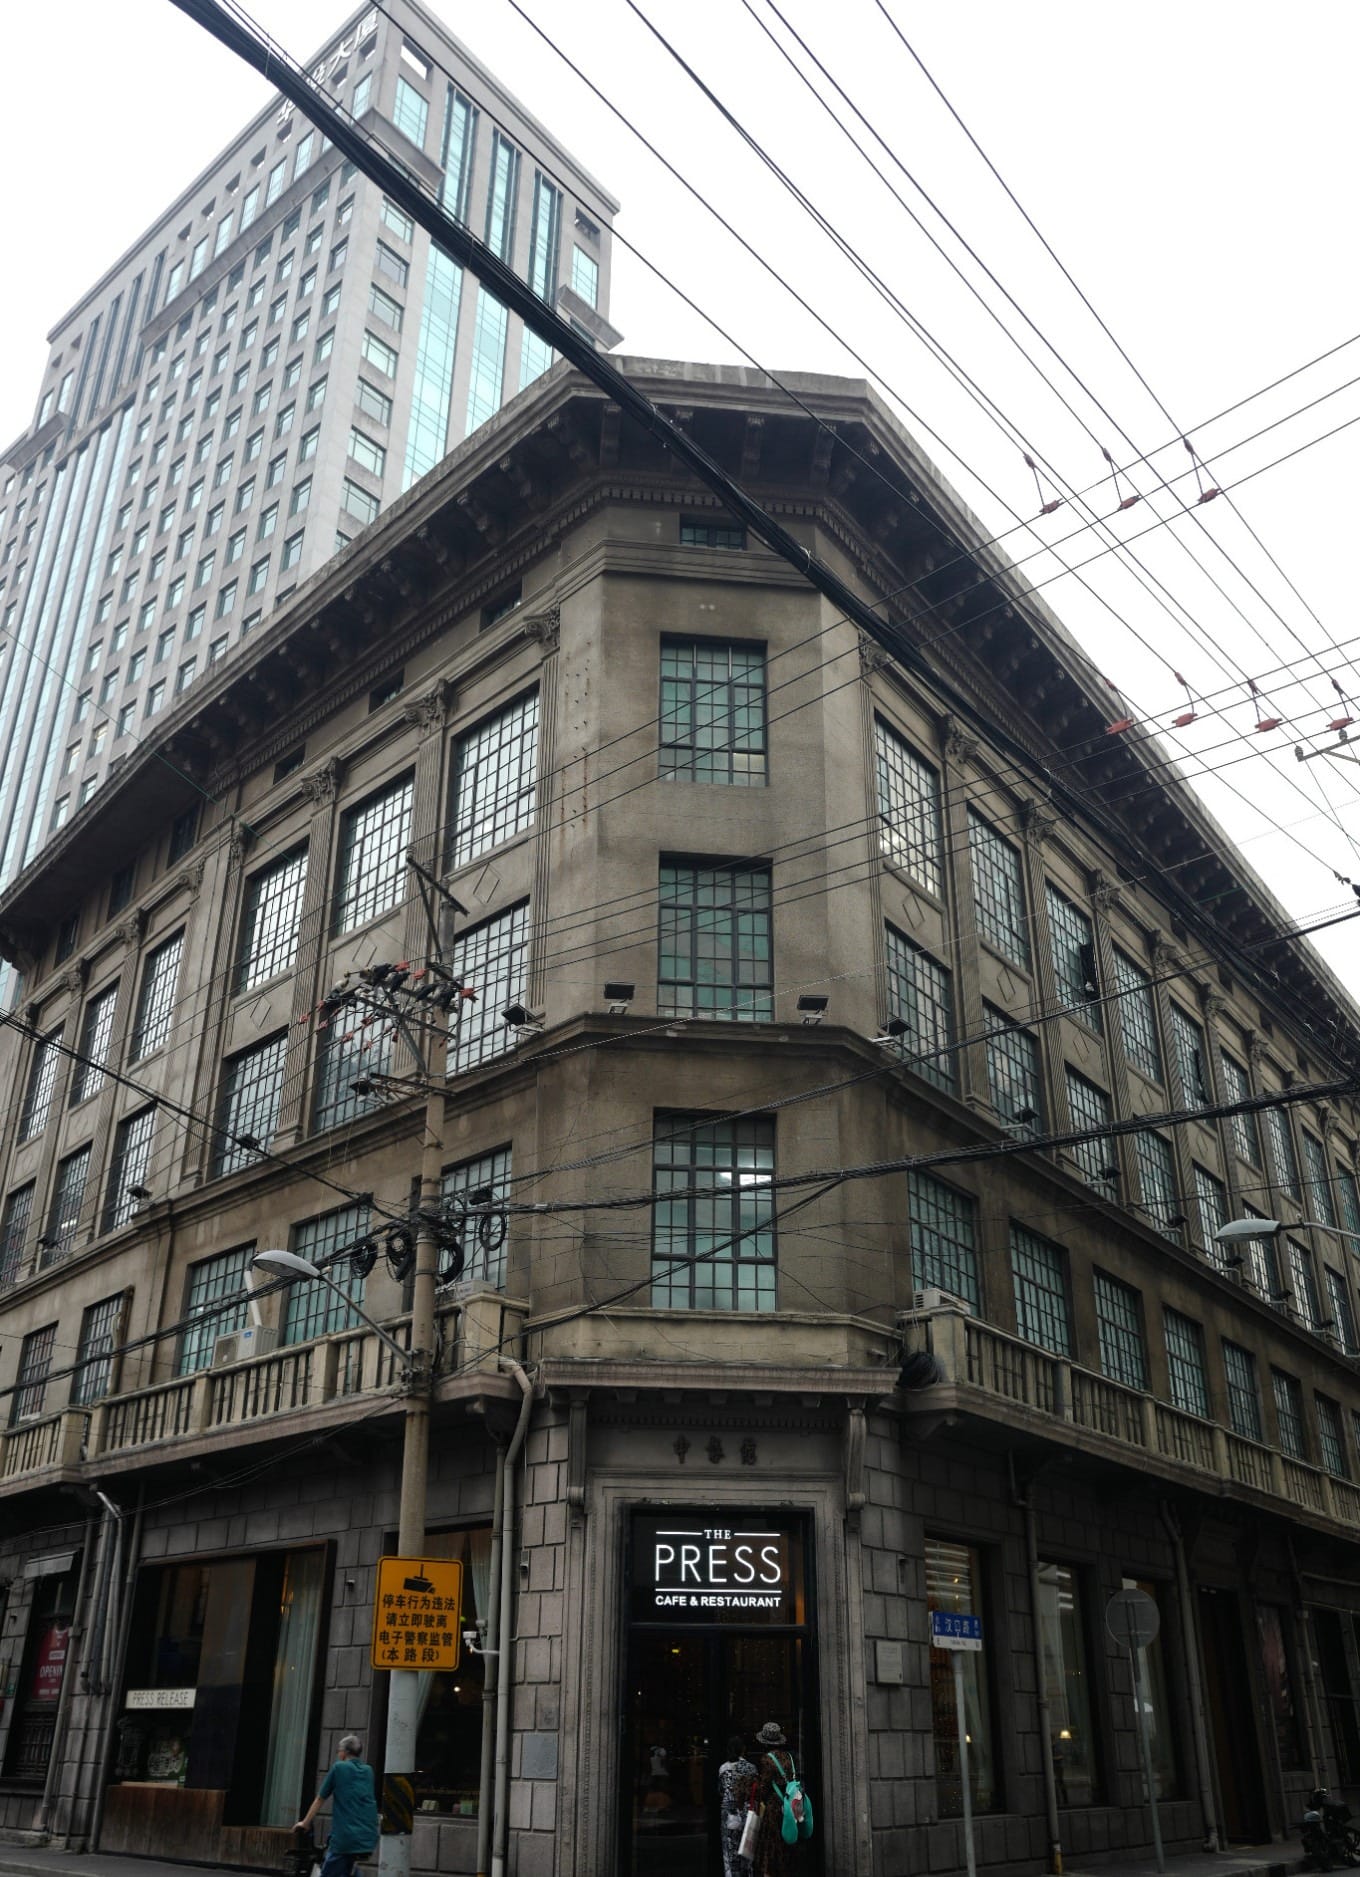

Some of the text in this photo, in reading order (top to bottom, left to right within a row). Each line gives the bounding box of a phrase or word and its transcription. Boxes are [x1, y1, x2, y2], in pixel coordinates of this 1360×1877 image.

[704, 1529, 731, 1540] THE
[655, 1544, 781, 1583] PRESS
[382, 1593, 455, 1611] 停车行为违法
[655, 1595, 781, 1608] CAFE & RESTAURANT
[386, 1613, 447, 1628] 请立即驶离
[379, 1630, 453, 1647] 电子警察监管
[132, 1690, 190, 1706] PRESS RELEASE
